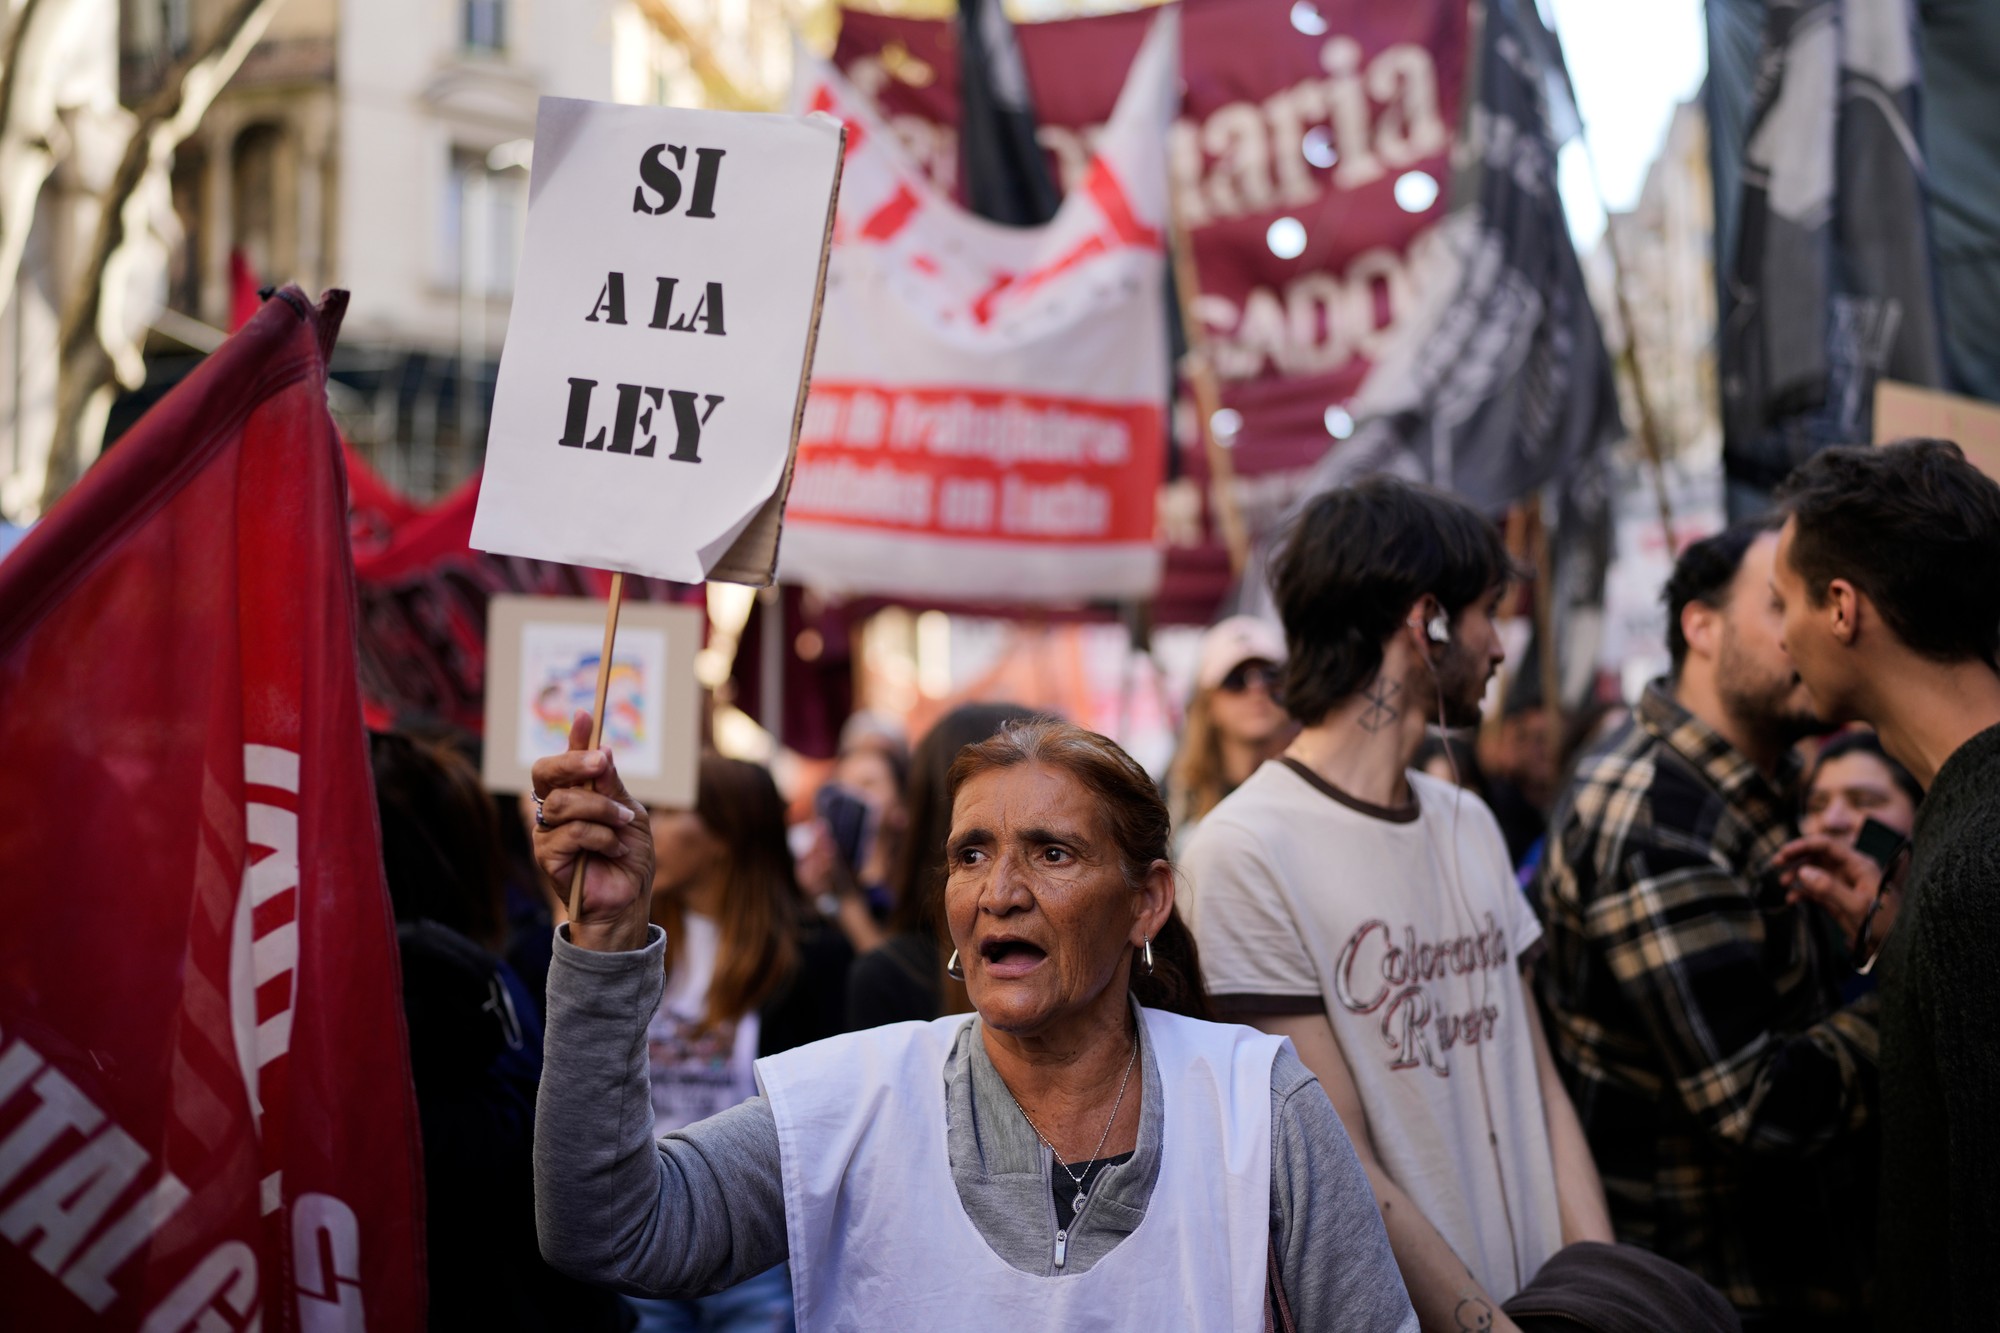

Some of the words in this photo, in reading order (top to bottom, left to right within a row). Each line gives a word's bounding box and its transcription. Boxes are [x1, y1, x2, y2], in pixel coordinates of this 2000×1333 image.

[633, 142, 727, 220] SI
[585, 270, 628, 326] A
[648, 276, 727, 337] LA
[558, 376, 725, 464] LEY
[1380, 985, 1498, 1078] River
